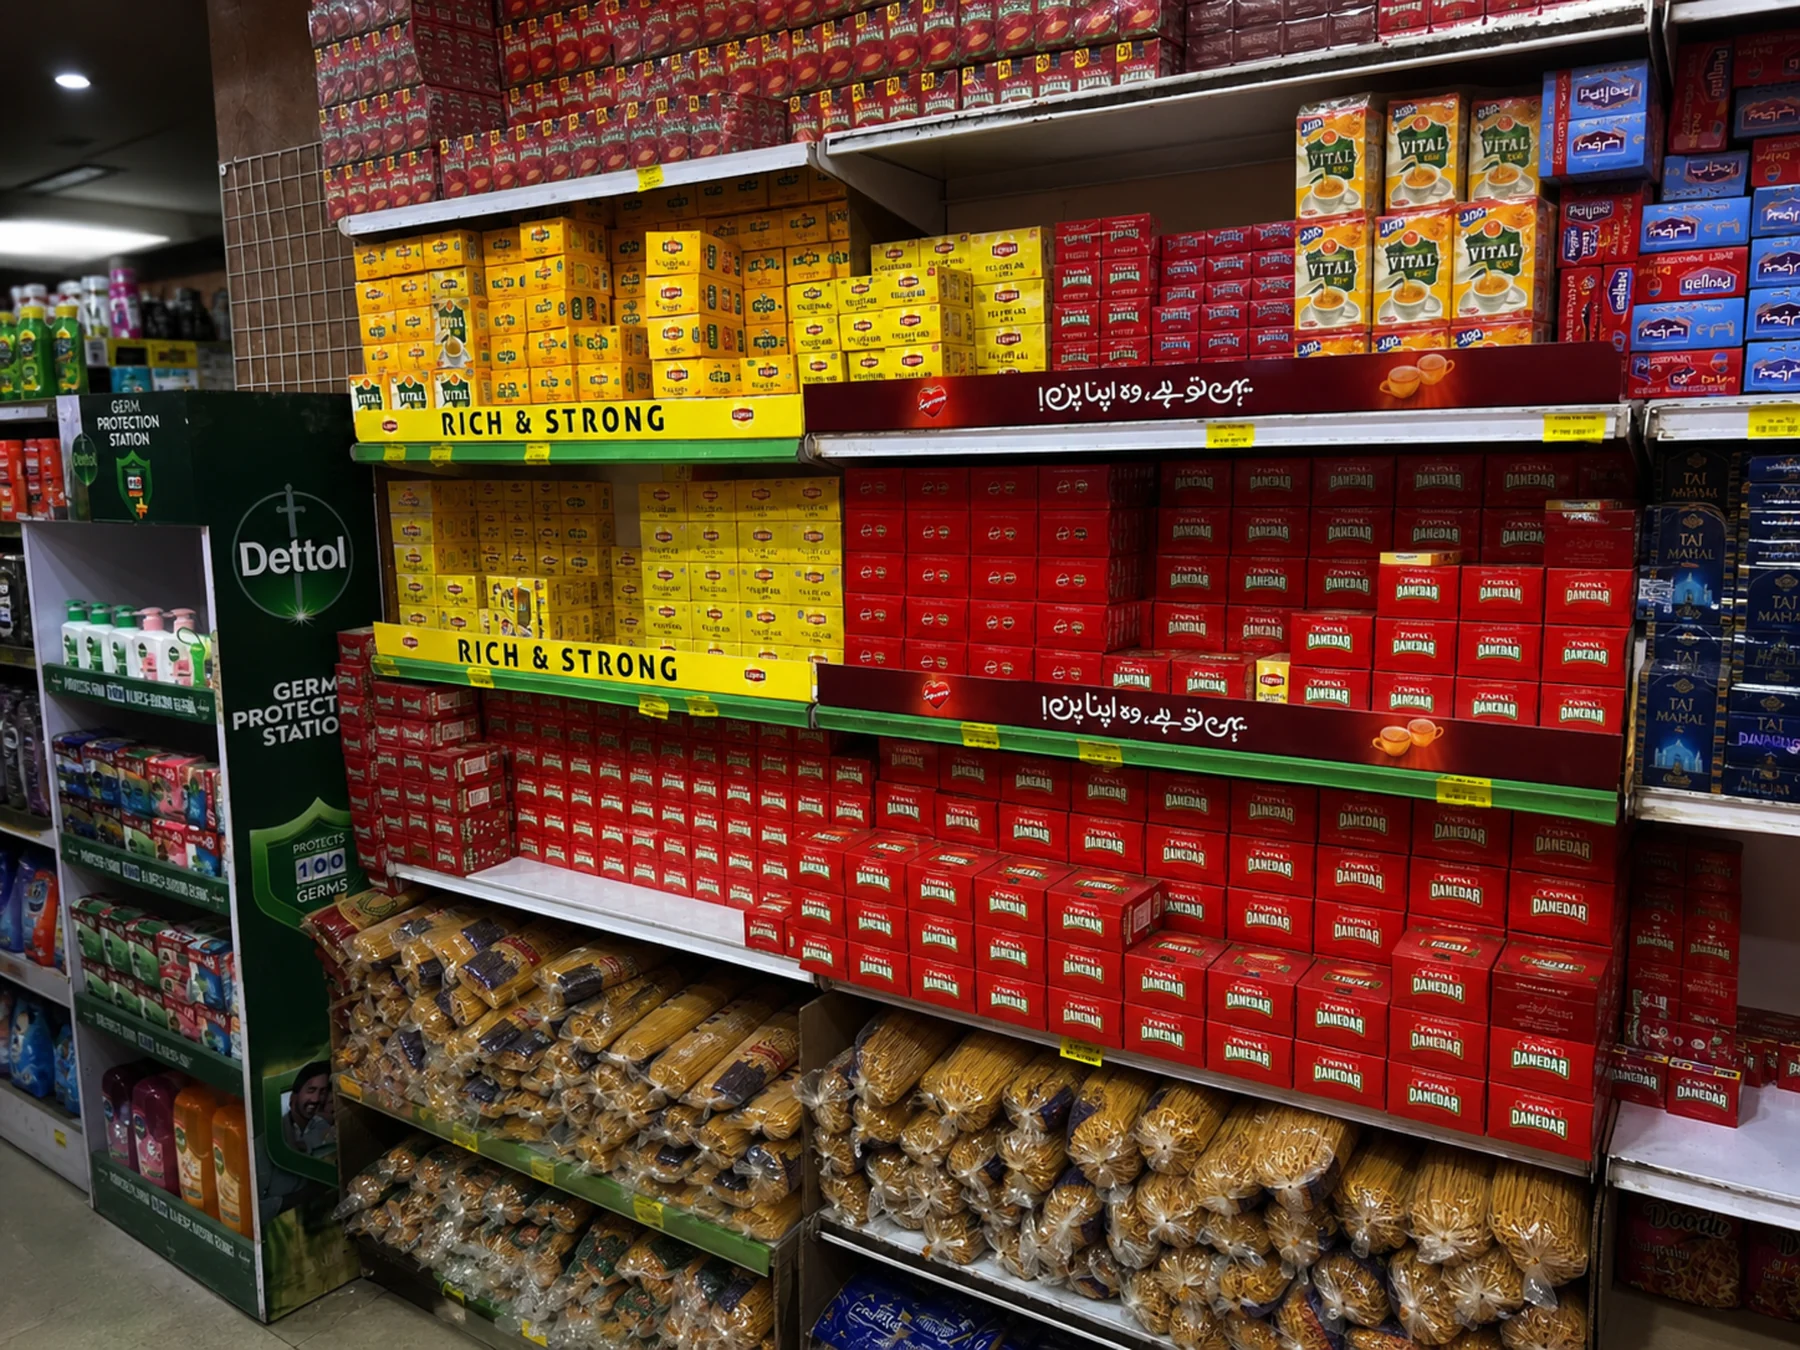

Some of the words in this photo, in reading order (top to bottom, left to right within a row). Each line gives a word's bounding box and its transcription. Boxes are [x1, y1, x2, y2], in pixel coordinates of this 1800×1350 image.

[1401, 137, 1446, 154] VITAL
[1484, 136, 1529, 153] VITAL
[1309, 150, 1354, 167] VITAL
[1389, 254, 1436, 269] VITAL
[1470, 244, 1519, 261] VITAL
[1309, 261, 1353, 276] VITAL
[1119, 384, 1143, 403] وہ
[1185, 376, 1207, 403] تو
[1208, 378, 1254, 407] یہی
[111, 400, 141, 414] GERM
[97, 415, 160, 430] PROTECTION
[442, 411, 501, 436] RICH
[515, 410, 532, 434] &
[547, 405, 665, 433] STRONG
[109, 432, 150, 446] STATION
[1680, 533, 1703, 546] TAJ
[240, 536, 347, 576] Dettol
[1667, 549, 1715, 559] MAHAL
[1772, 595, 1798, 609] TAJ
[1757, 611, 1800, 623] MAHA
[458, 639, 519, 668] RICH
[533, 646, 549, 669] &
[562, 648, 677, 682] STRONG
[273, 676, 339, 700] GERM
[232, 695, 338, 730] PROTECT
[1119, 705, 1142, 724] وہ
[1669, 697, 1695, 710] TAJ
[1181, 708, 1204, 731] تو
[1205, 716, 1248, 742] یہی
[1656, 711, 1706, 725] MAHAL
[263, 716, 339, 746] STATIO
[293, 832, 345, 854] PROTECTS
[298, 854, 344, 878] 100
[1248, 857, 1292, 876] DANEDAR
[297, 878, 348, 903] GERMS
[1337, 869, 1383, 890] DANEDAR
[1431, 882, 1481, 904] DANEDAR
[1533, 898, 1587, 921] DANEDAR
[1247, 911, 1291, 931] DANEDAR
[1334, 923, 1380, 945] DANEDAR
[1413, 978, 1464, 1000] DANEDAR
[1227, 992, 1271, 1015] DANEDAR
[1316, 1011, 1364, 1034] DANEDAR
[1226, 1045, 1271, 1068] DANEDAR
[1412, 1034, 1462, 1057] DANEDAR
[1513, 1051, 1568, 1077] DANEDAR
[1315, 1065, 1361, 1089] DANEDAR
[1409, 1088, 1460, 1114] DANEDAR
[1677, 1086, 1727, 1112] DANEDAR
[1511, 1109, 1567, 1138] DANEDAR
